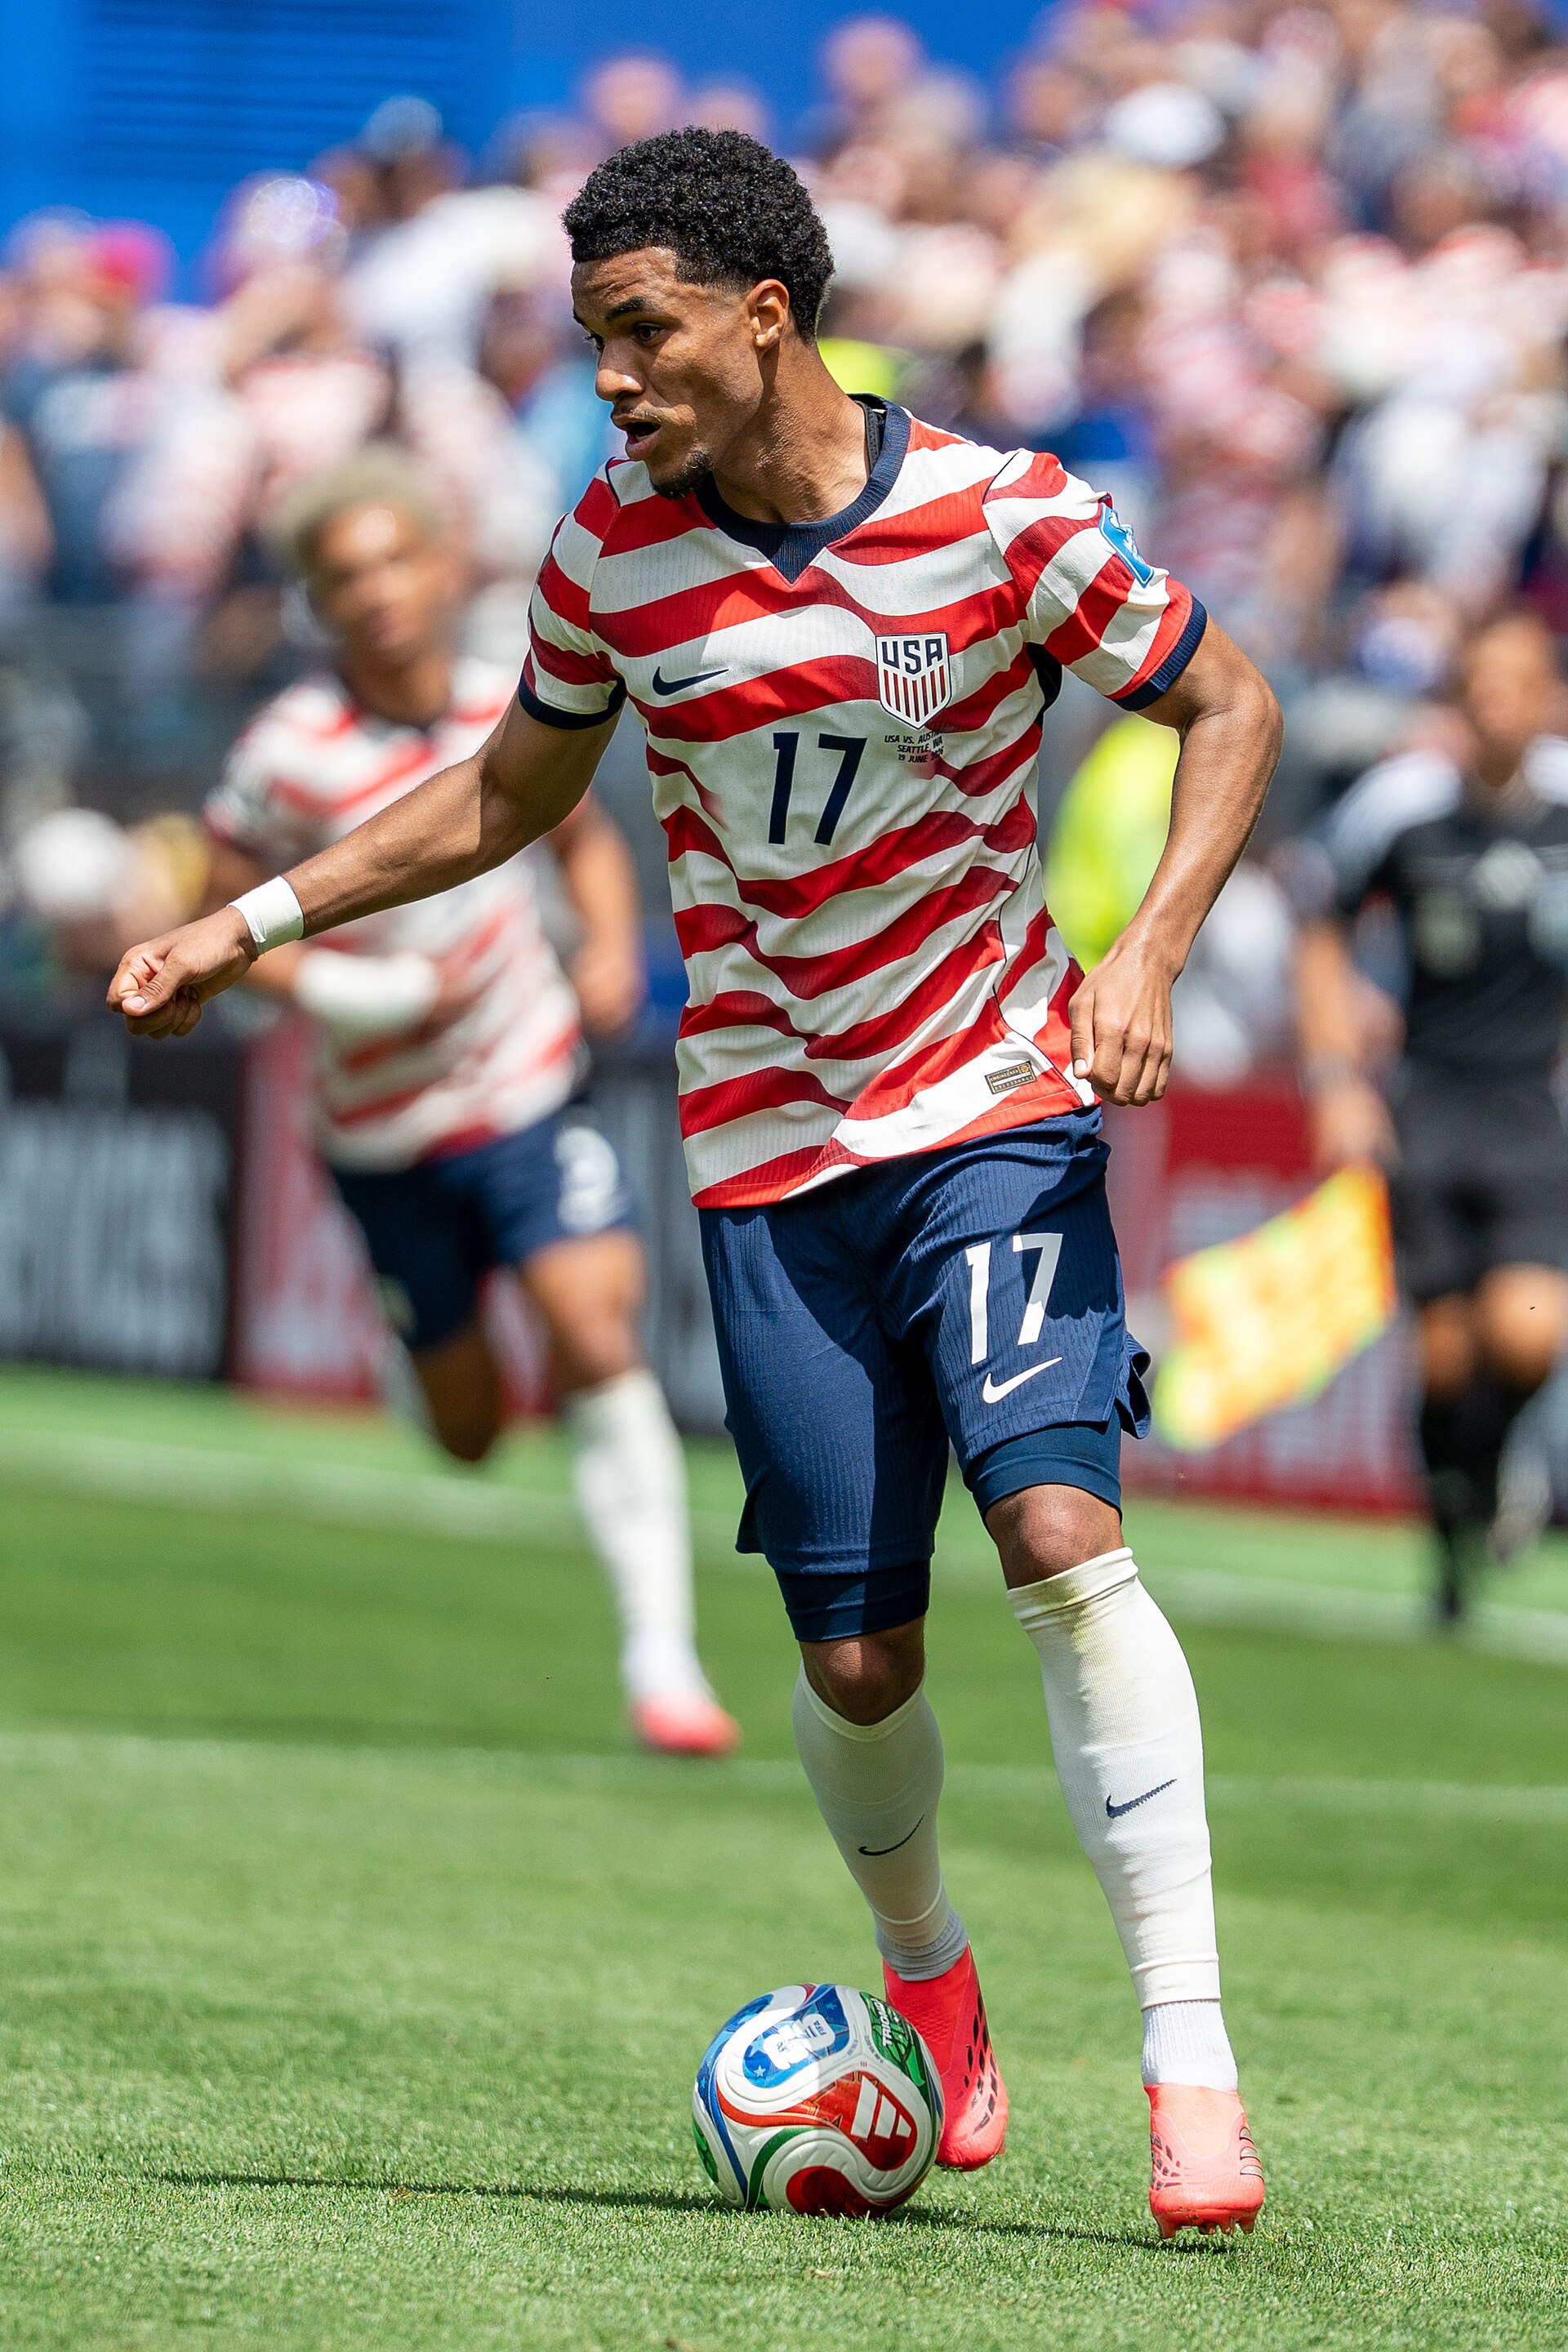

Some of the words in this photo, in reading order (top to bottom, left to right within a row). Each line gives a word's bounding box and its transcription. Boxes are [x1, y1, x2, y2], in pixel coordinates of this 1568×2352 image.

[882, 639, 942, 675] USA
[884, 735, 900, 743] USA
[933, 736, 942, 749] WA
[908, 755, 928, 763] JUNE
[768, 732, 867, 846] 17
[965, 1233, 1063, 1365] 17
[813, 2020, 827, 2036] FIFA
